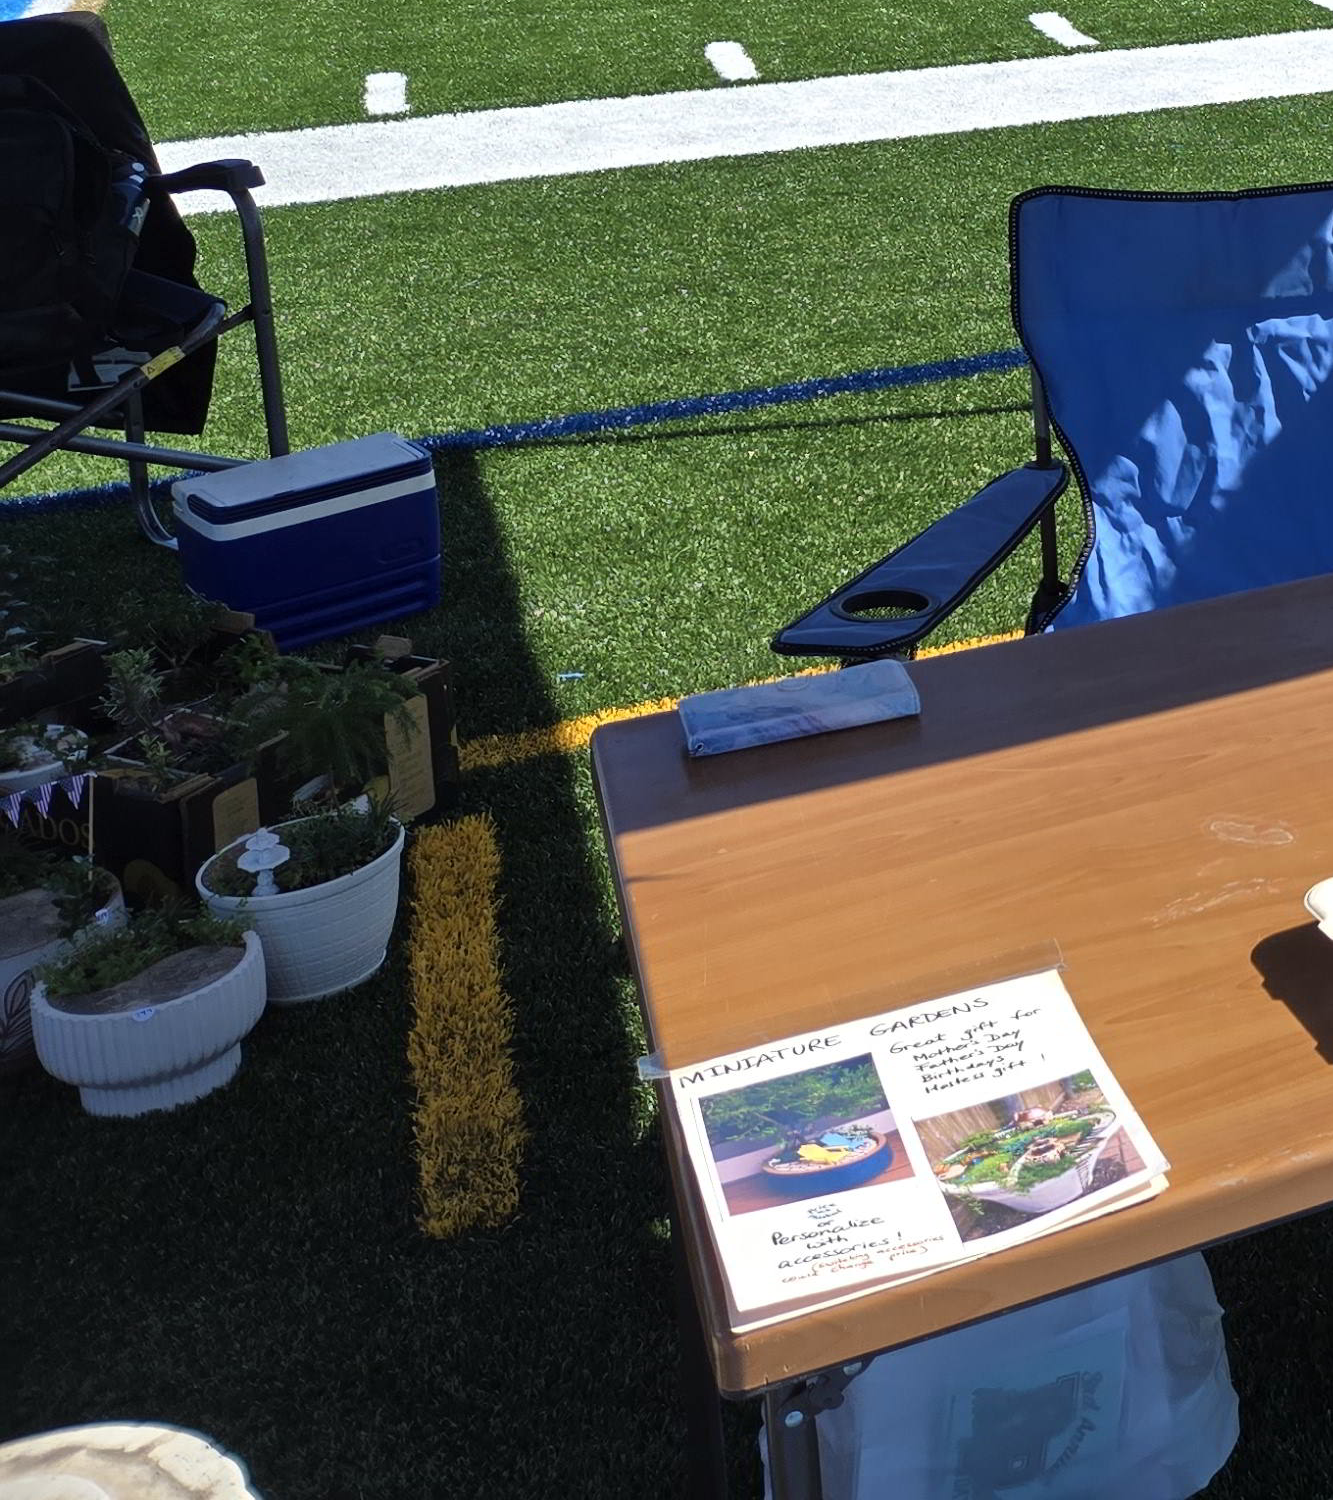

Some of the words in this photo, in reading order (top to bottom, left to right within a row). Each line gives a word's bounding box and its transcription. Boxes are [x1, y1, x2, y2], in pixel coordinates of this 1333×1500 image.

[678, 1035, 843, 1090] MINIATURE
[869, 998, 990, 1037] GARDENS
[890, 1033, 947, 1054] Great
[960, 1020, 999, 1041] gift
[1010, 1008, 1043, 1021] for
[983, 1029, 1021, 1043] Day
[771, 1216, 885, 1247] Personalize
[806, 1235, 849, 1250] with
